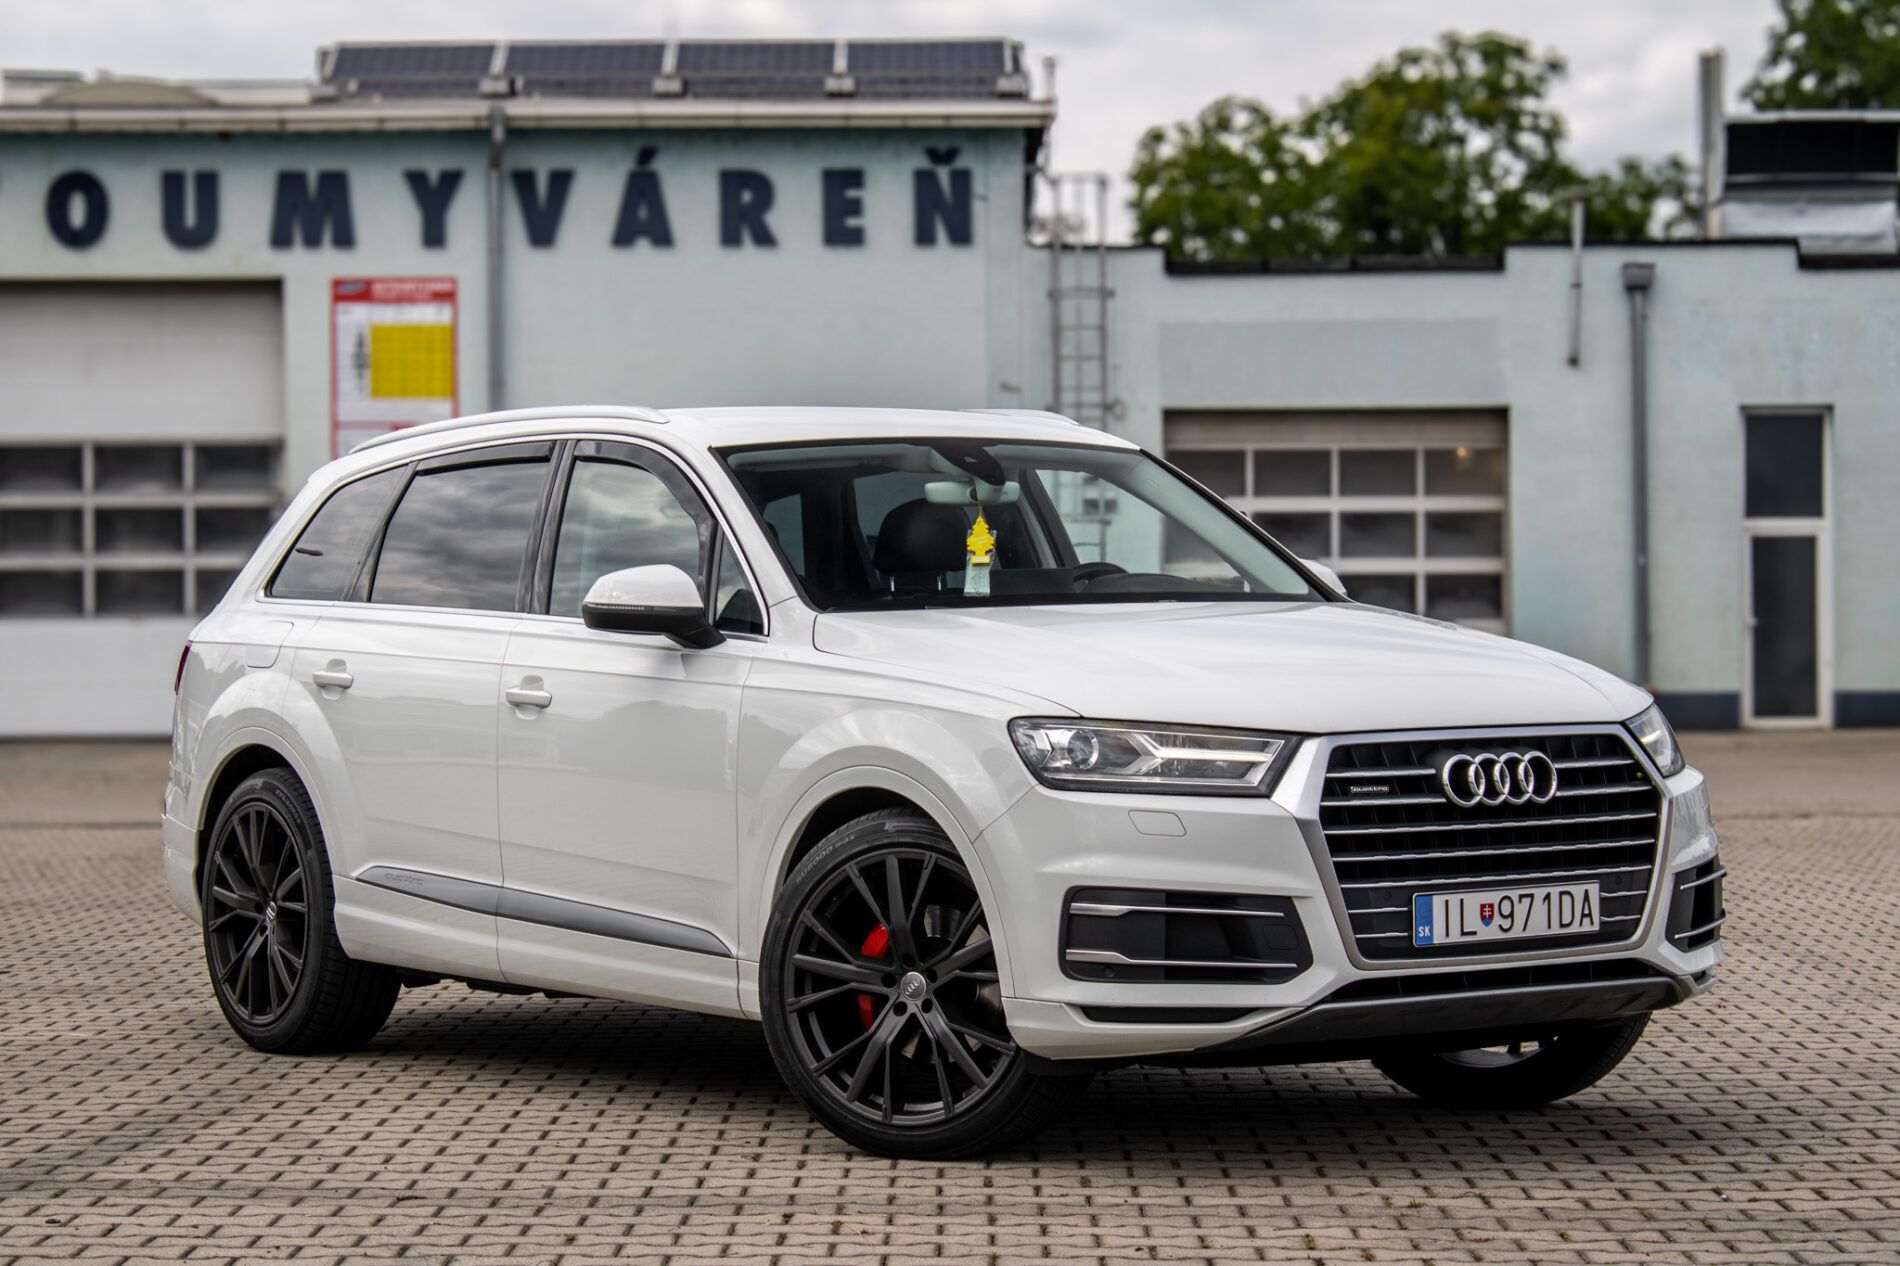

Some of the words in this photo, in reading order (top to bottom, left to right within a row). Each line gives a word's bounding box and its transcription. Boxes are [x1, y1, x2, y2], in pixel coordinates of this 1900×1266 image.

[45, 147, 974, 251] OUMYVÁREŇ
[1418, 925, 1431, 937] SK
[1444, 898, 1477, 938] IL
[1498, 888, 1595, 933] 971DA
